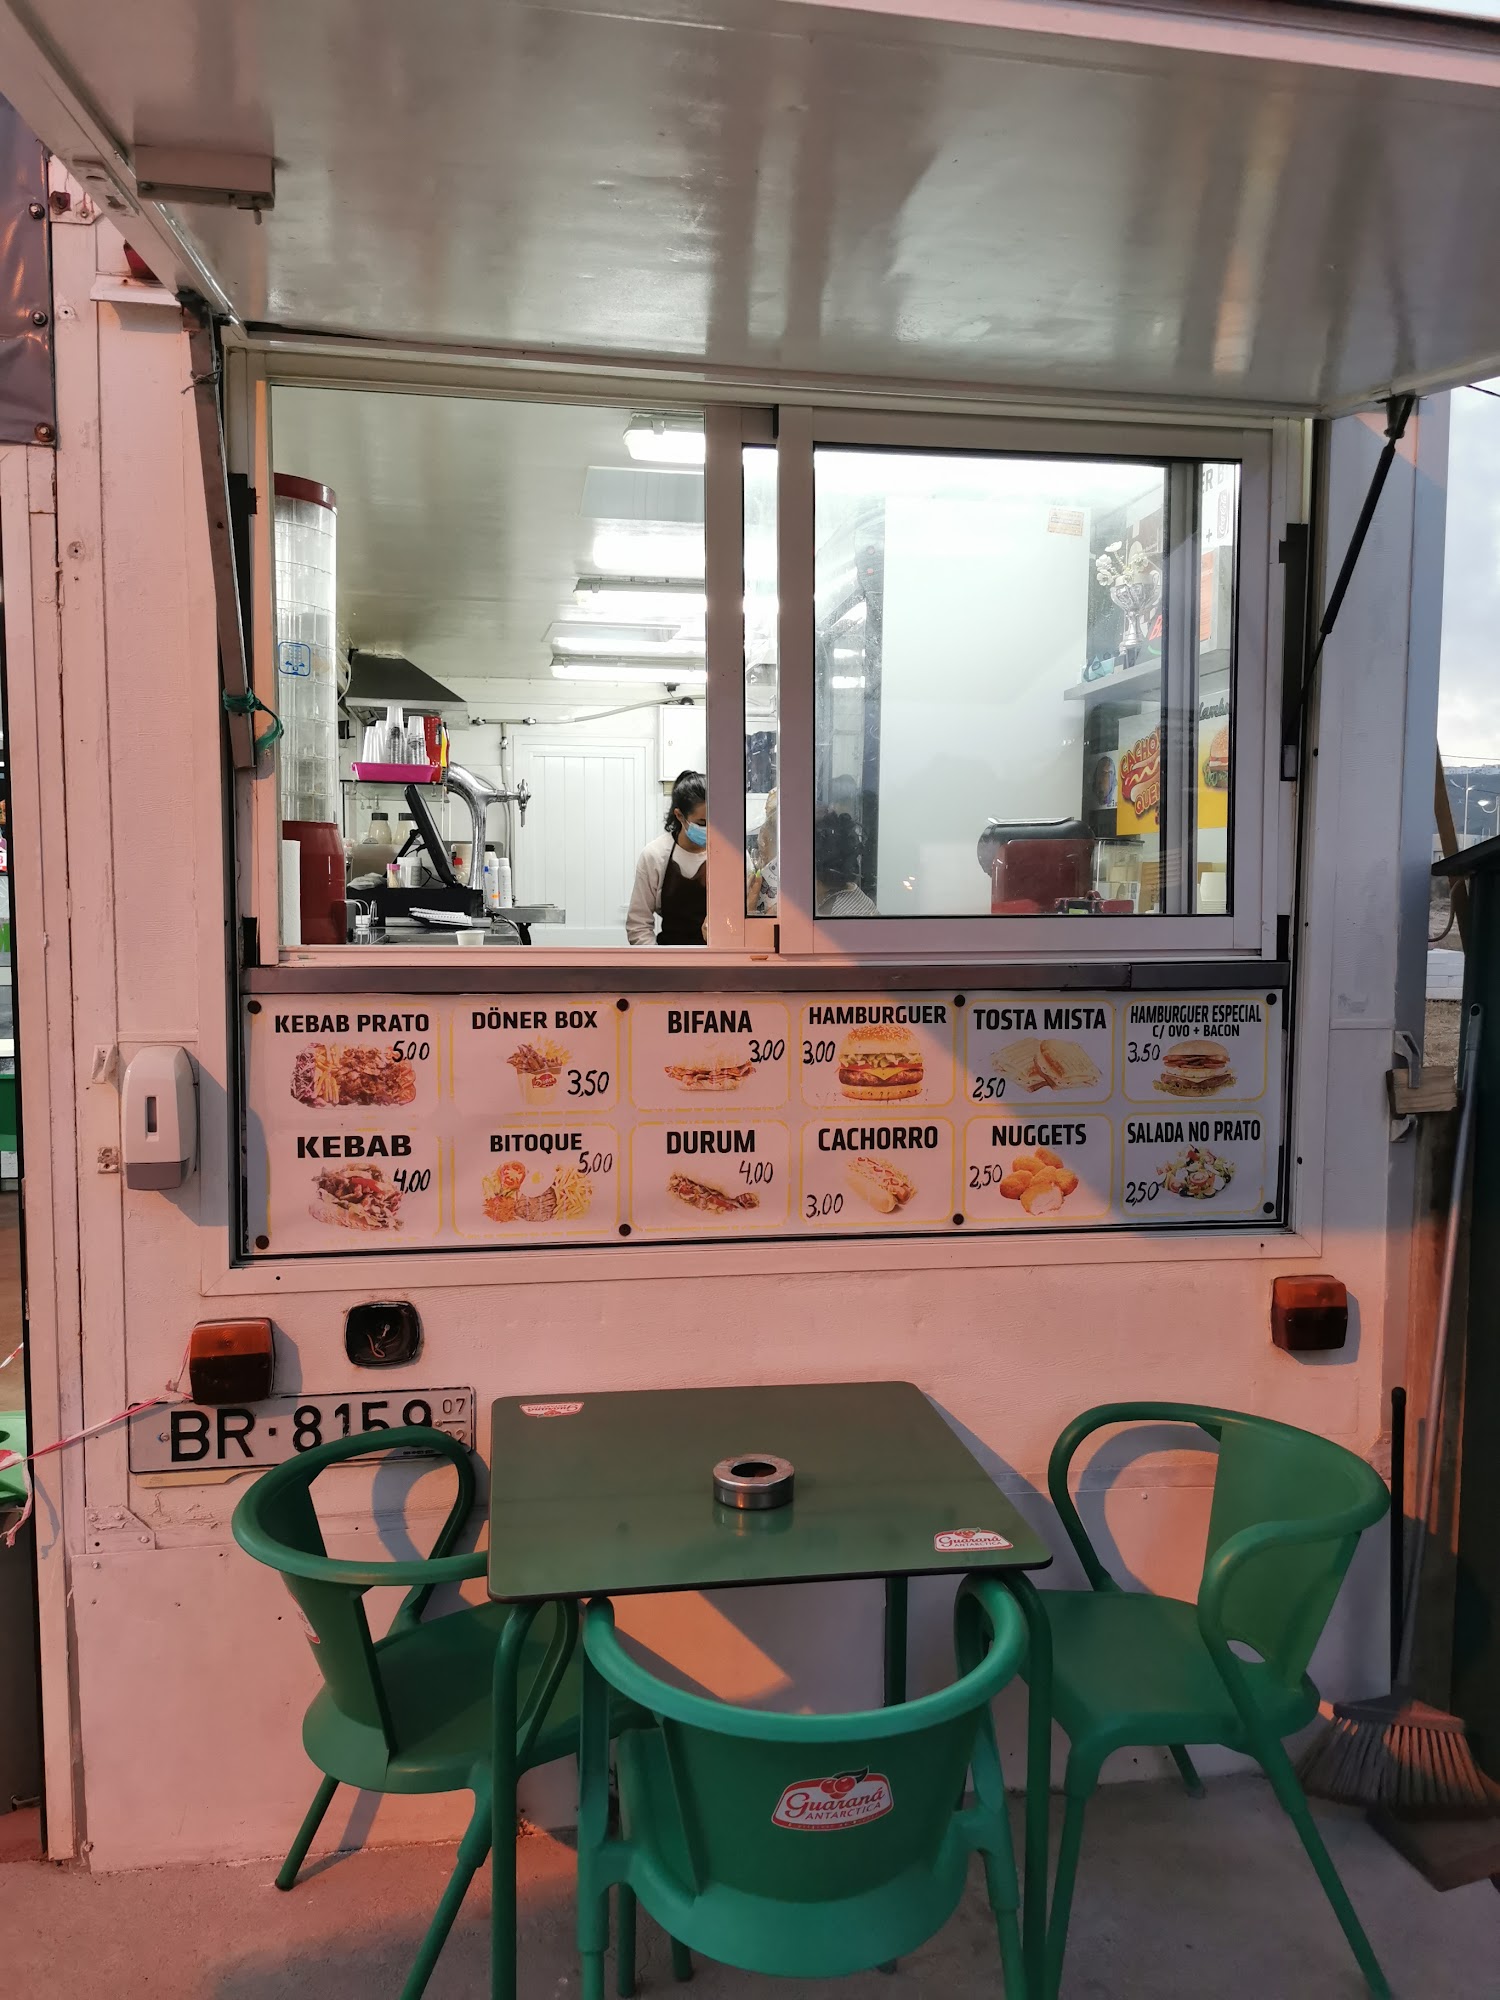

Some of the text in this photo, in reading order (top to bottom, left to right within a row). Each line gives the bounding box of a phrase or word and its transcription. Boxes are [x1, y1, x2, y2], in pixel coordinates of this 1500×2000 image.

[275, 1014, 429, 1033] KEBAB PRATO
[472, 1007, 597, 1029] DÖNER BOX
[668, 1010, 752, 1033] BIFANA
[809, 1006, 947, 1025] HAMBURGUER
[974, 1009, 1106, 1030] TOSTA MISTA
[1131, 1004, 1261, 1024] HAMBURGUER ESPECIAL
[1152, 1024, 1240, 1038] C/ OVO + BACON
[748, 1039, 785, 1063] 3,00
[803, 1040, 835, 1065] 3,00
[1128, 1042, 1160, 1063] 3,50
[567, 1070, 609, 1098] 3,50
[667, 1130, 755, 1154] DURUM
[818, 1126, 938, 1151] CACHORRO
[992, 1124, 1086, 1146] NUGGETS
[1128, 1120, 1260, 1143] SALADA NO PRATO
[297, 1135, 412, 1158] KEBAB
[490, 1133, 582, 1154] BITOQUE
[970, 1164, 1002, 1189] 2,50
[806, 1193, 843, 1218] 3,00
[443, 1398, 465, 1414] 07
[939, 1536, 1001, 1547] Guaraná
[785, 1787, 885, 1818] Guaraná
[805, 1802, 881, 1820] ANTARCTICA
